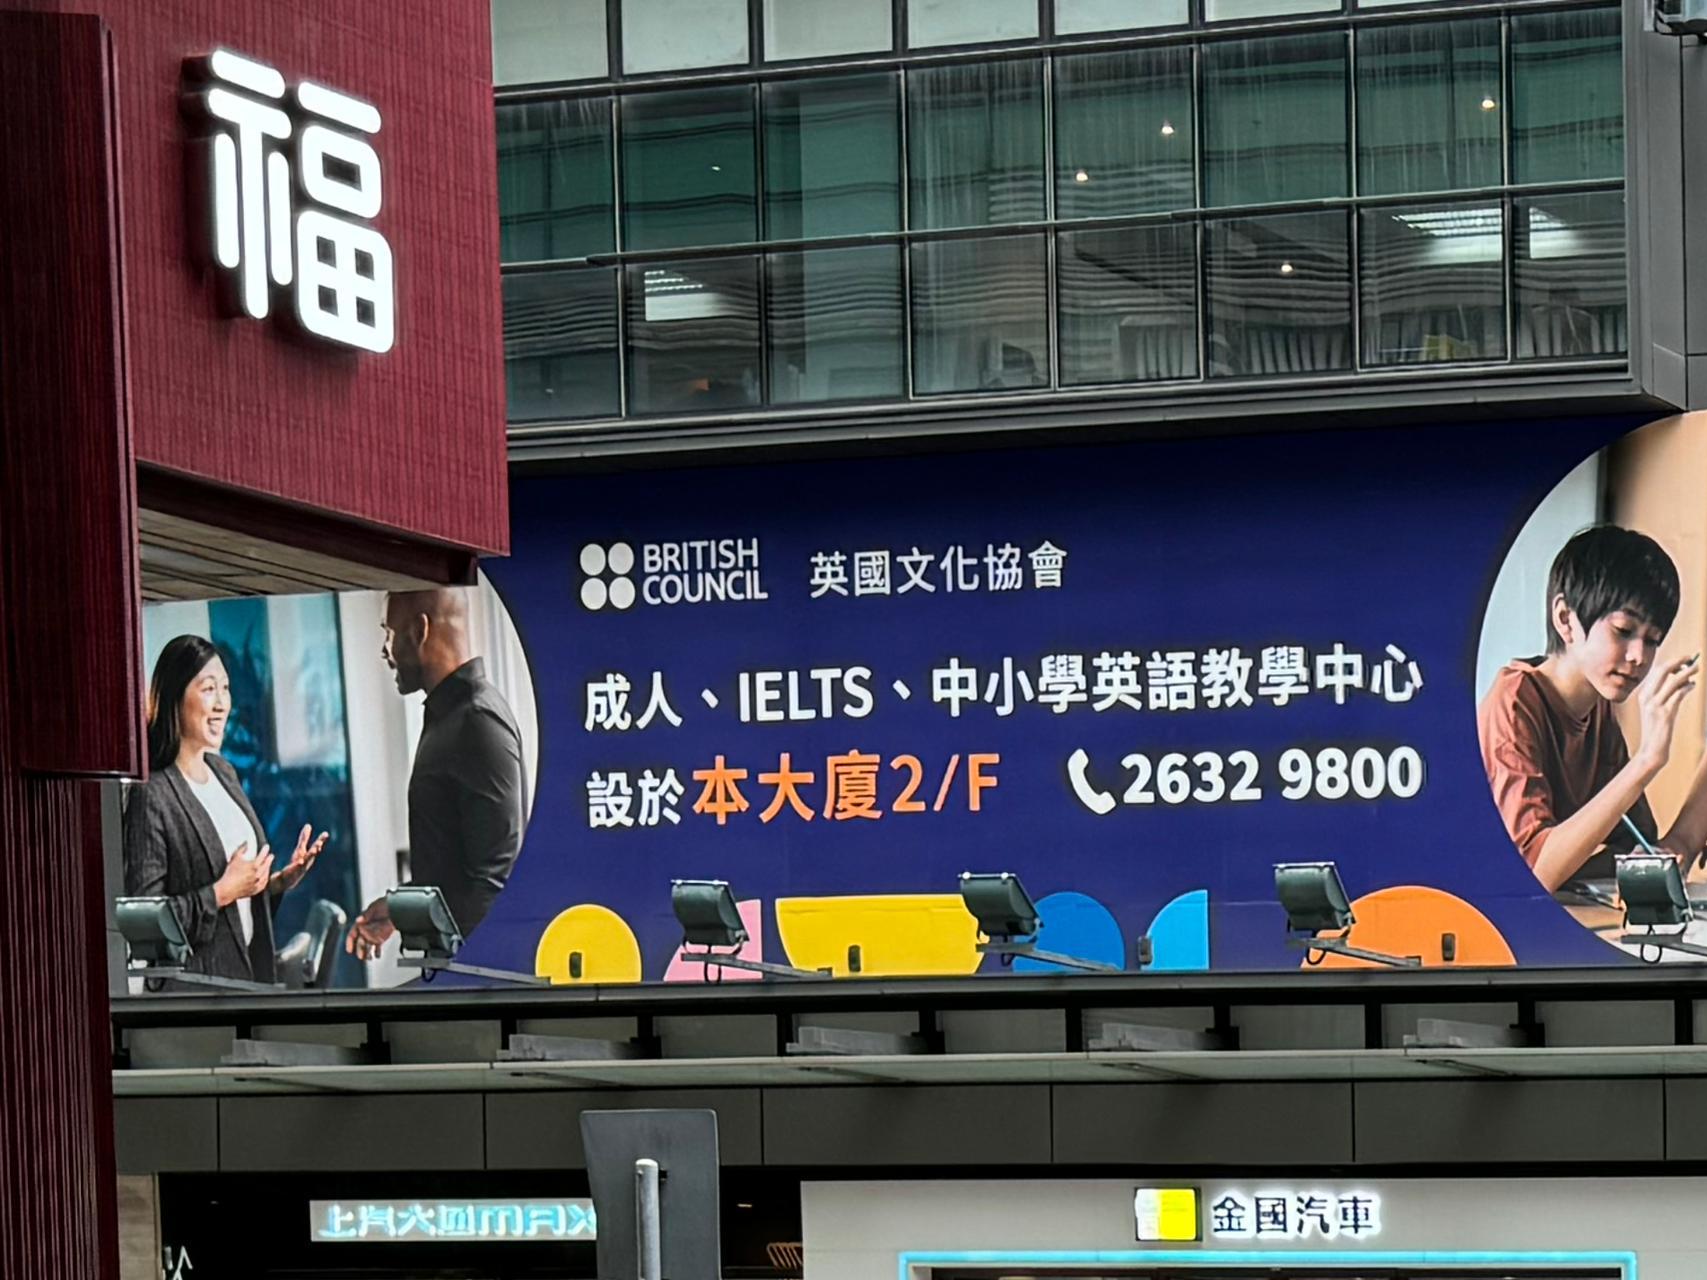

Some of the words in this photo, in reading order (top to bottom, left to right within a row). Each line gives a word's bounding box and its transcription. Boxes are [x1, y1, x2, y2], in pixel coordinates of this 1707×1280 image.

[207, 50, 395, 353] 福
[643, 537, 759, 575] BRITISH
[809, 540, 1068, 599] 英國文化協會
[642, 565, 768, 605] COUNCIL
[1121, 752, 1262, 804] 2632
[1279, 746, 1424, 800] 9800
[1211, 1195, 1375, 1235] 金國汽車
